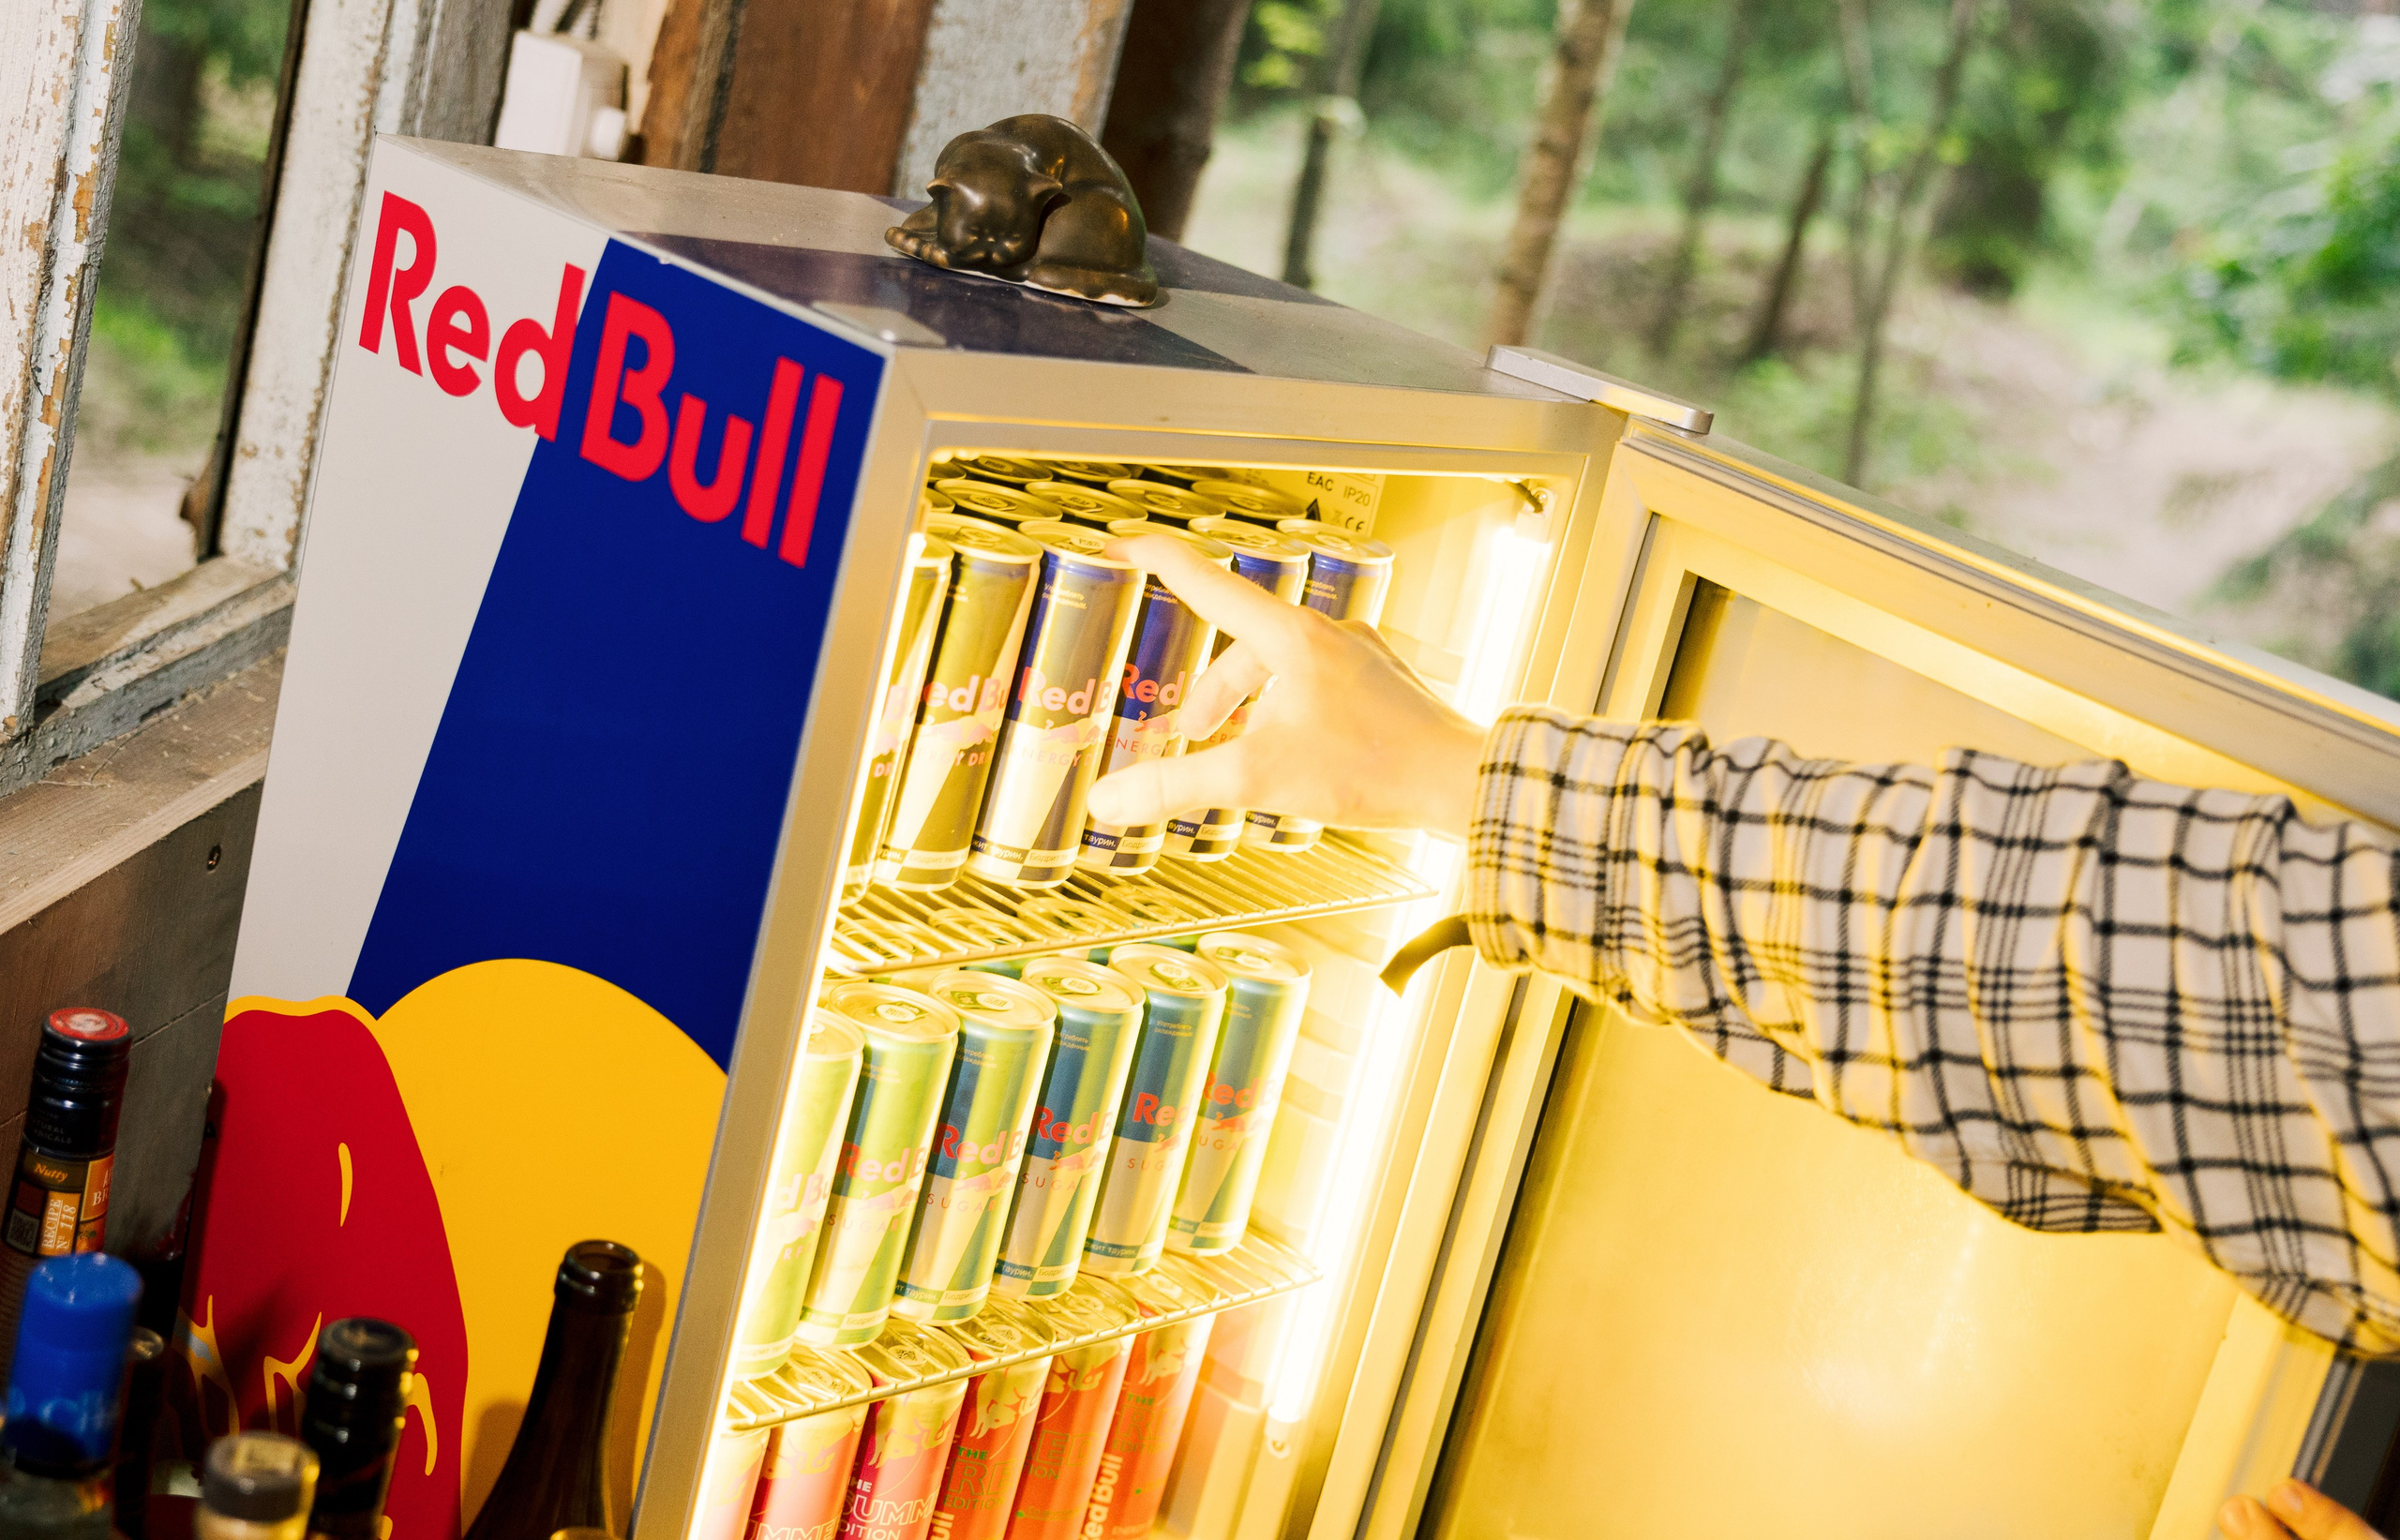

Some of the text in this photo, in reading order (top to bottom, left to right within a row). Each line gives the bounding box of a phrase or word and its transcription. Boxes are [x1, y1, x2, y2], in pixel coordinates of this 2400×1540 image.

[359, 190, 845, 569] Red Bull
[1307, 471, 1334, 491] EAC
[1343, 486, 1371, 507] IP20
[922, 674, 981, 713] ed
[1017, 665, 1097, 715] Red
[933, 1121, 1008, 1165] Red
[1029, 1105, 1100, 1145] Red
[34, 1162, 68, 1183] Nutty
[41, 1199, 64, 1249] RECIPE
[60, 1204, 77, 1230] 118
[957, 1445, 989, 1461] THE
